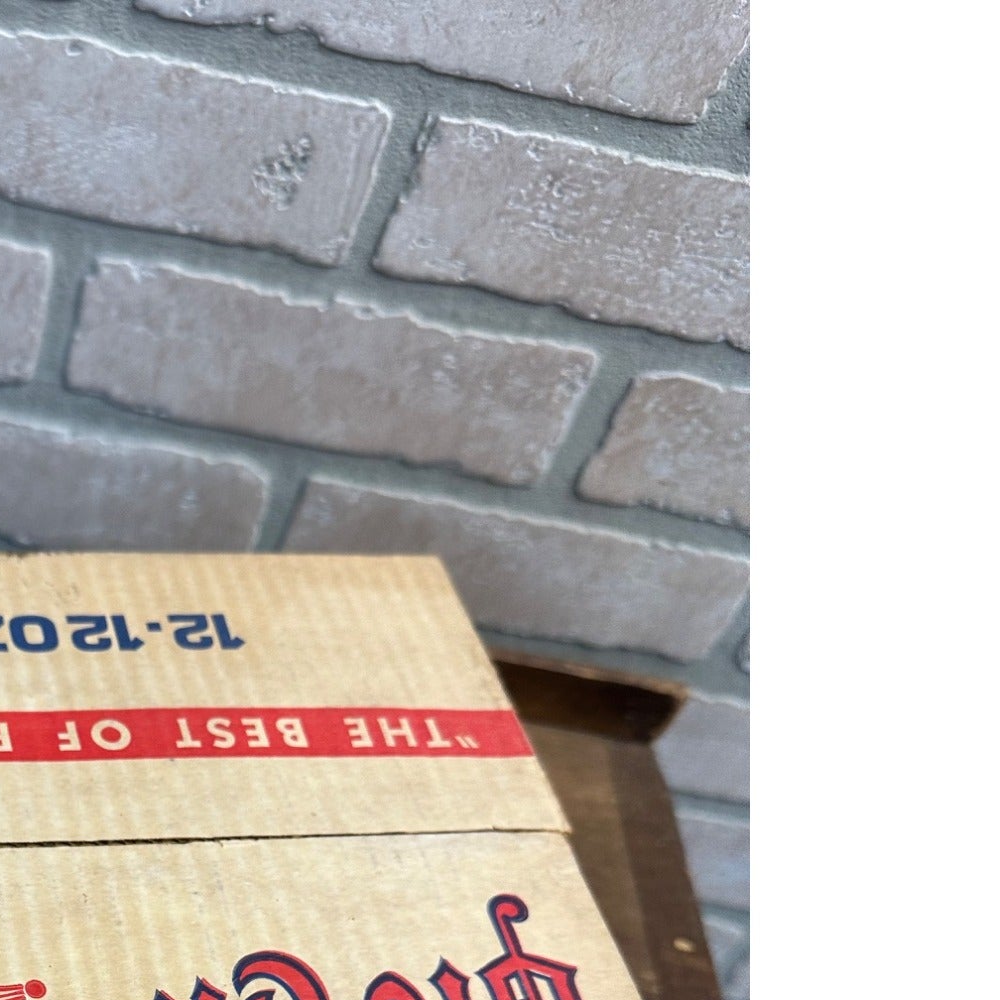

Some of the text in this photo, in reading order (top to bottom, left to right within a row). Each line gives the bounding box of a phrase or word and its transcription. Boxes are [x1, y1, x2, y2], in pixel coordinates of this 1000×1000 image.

[57, 718, 132, 752] OF
[175, 716, 310, 750] BEST
[343, 716, 480, 750] "THE
